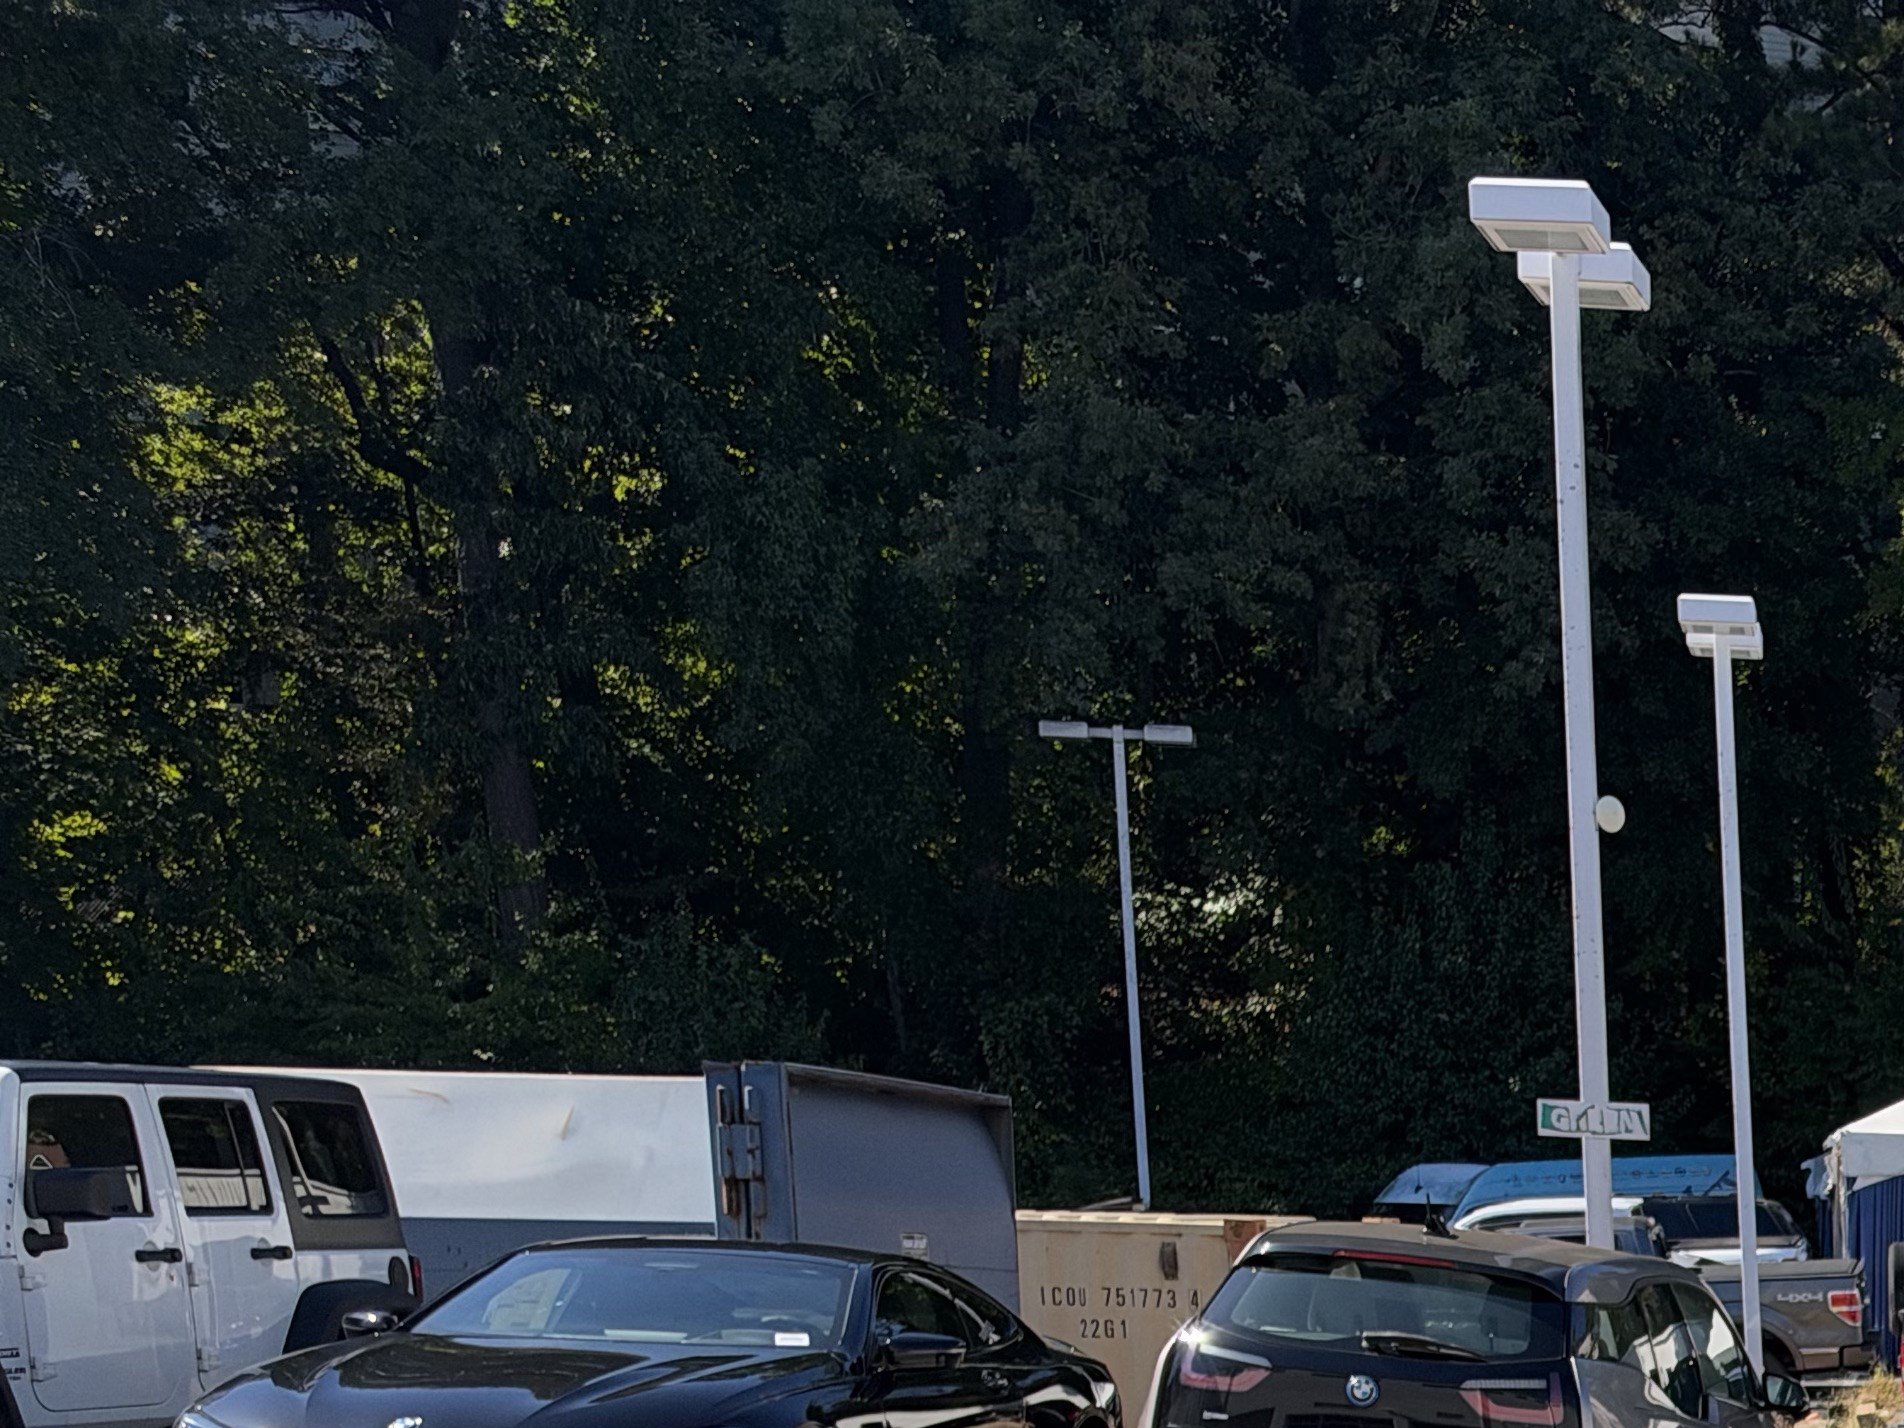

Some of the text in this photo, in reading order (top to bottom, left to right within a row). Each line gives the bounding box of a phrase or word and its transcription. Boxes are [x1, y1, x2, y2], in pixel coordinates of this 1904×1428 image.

[1101, 1287, 1177, 1308] 751773
[1190, 1289, 1199, 1309] 4
[1080, 1318, 1127, 1339] 22G1
